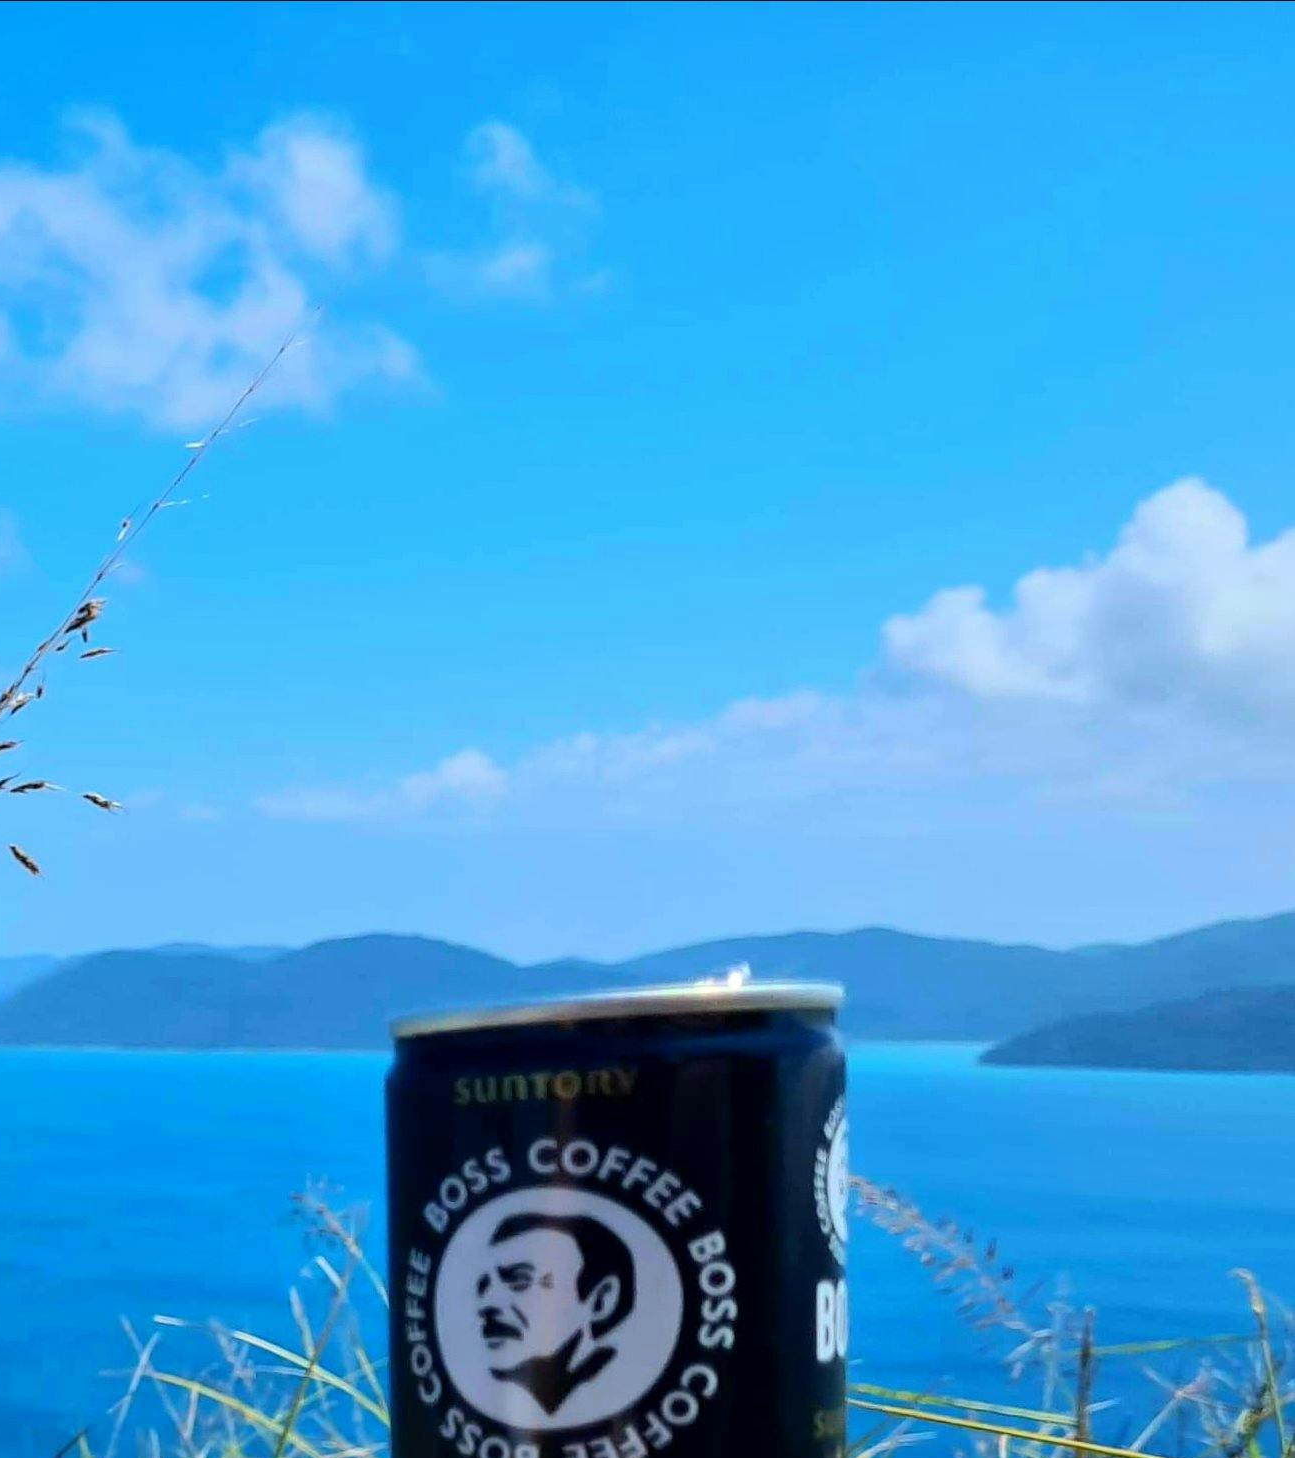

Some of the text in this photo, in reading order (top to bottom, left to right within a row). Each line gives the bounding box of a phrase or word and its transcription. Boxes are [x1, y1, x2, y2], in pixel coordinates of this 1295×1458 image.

[422, 1147, 510, 1232] BOSS
[527, 1138, 702, 1226] COFFEE
[406, 1246, 442, 1404] COFFEE
[689, 1229, 738, 1349] BOSS
